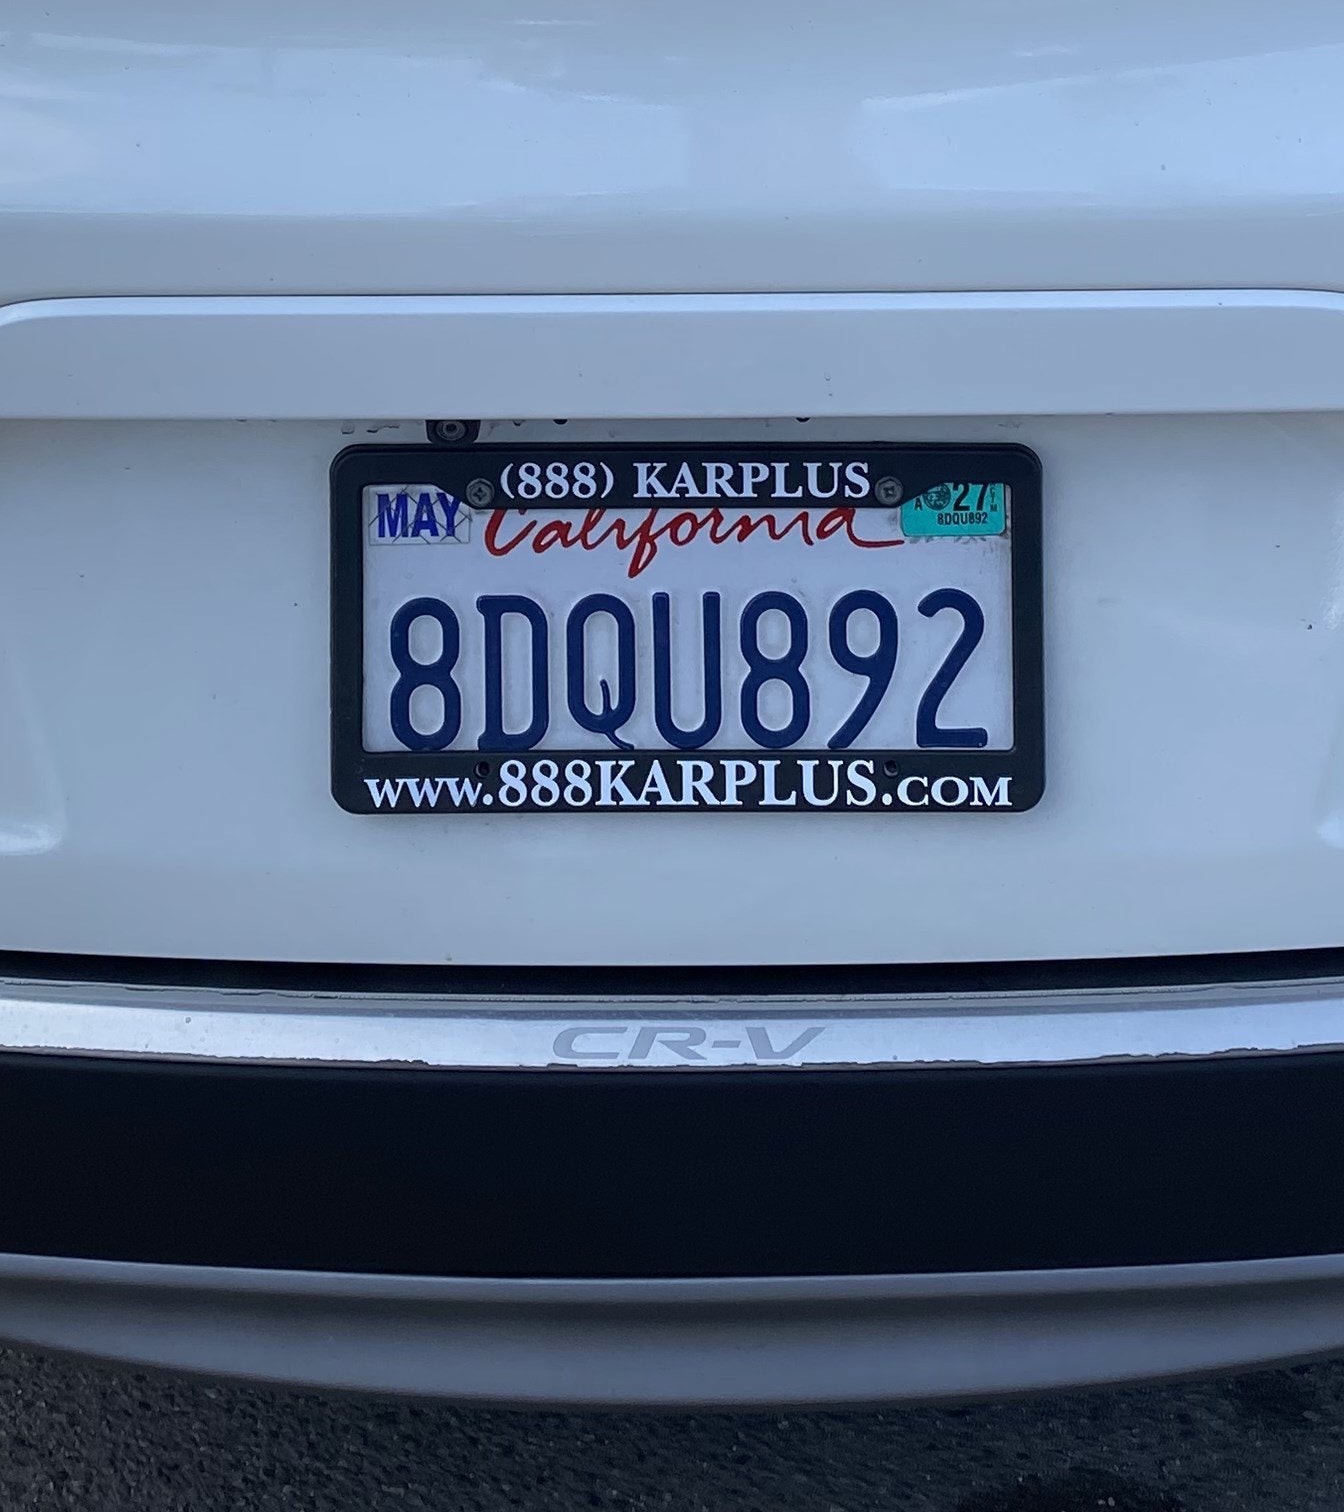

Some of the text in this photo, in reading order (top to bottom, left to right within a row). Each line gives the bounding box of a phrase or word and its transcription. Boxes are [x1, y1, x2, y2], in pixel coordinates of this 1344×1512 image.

[500, 461, 871, 500] (888) KARPLUS
[952, 483, 990, 512] 27
[377, 491, 463, 539] MAY
[937, 512, 989, 525] 8DQU892
[389, 588, 989, 750] 8DQU892
[552, 1026, 826, 1061] CR-V
